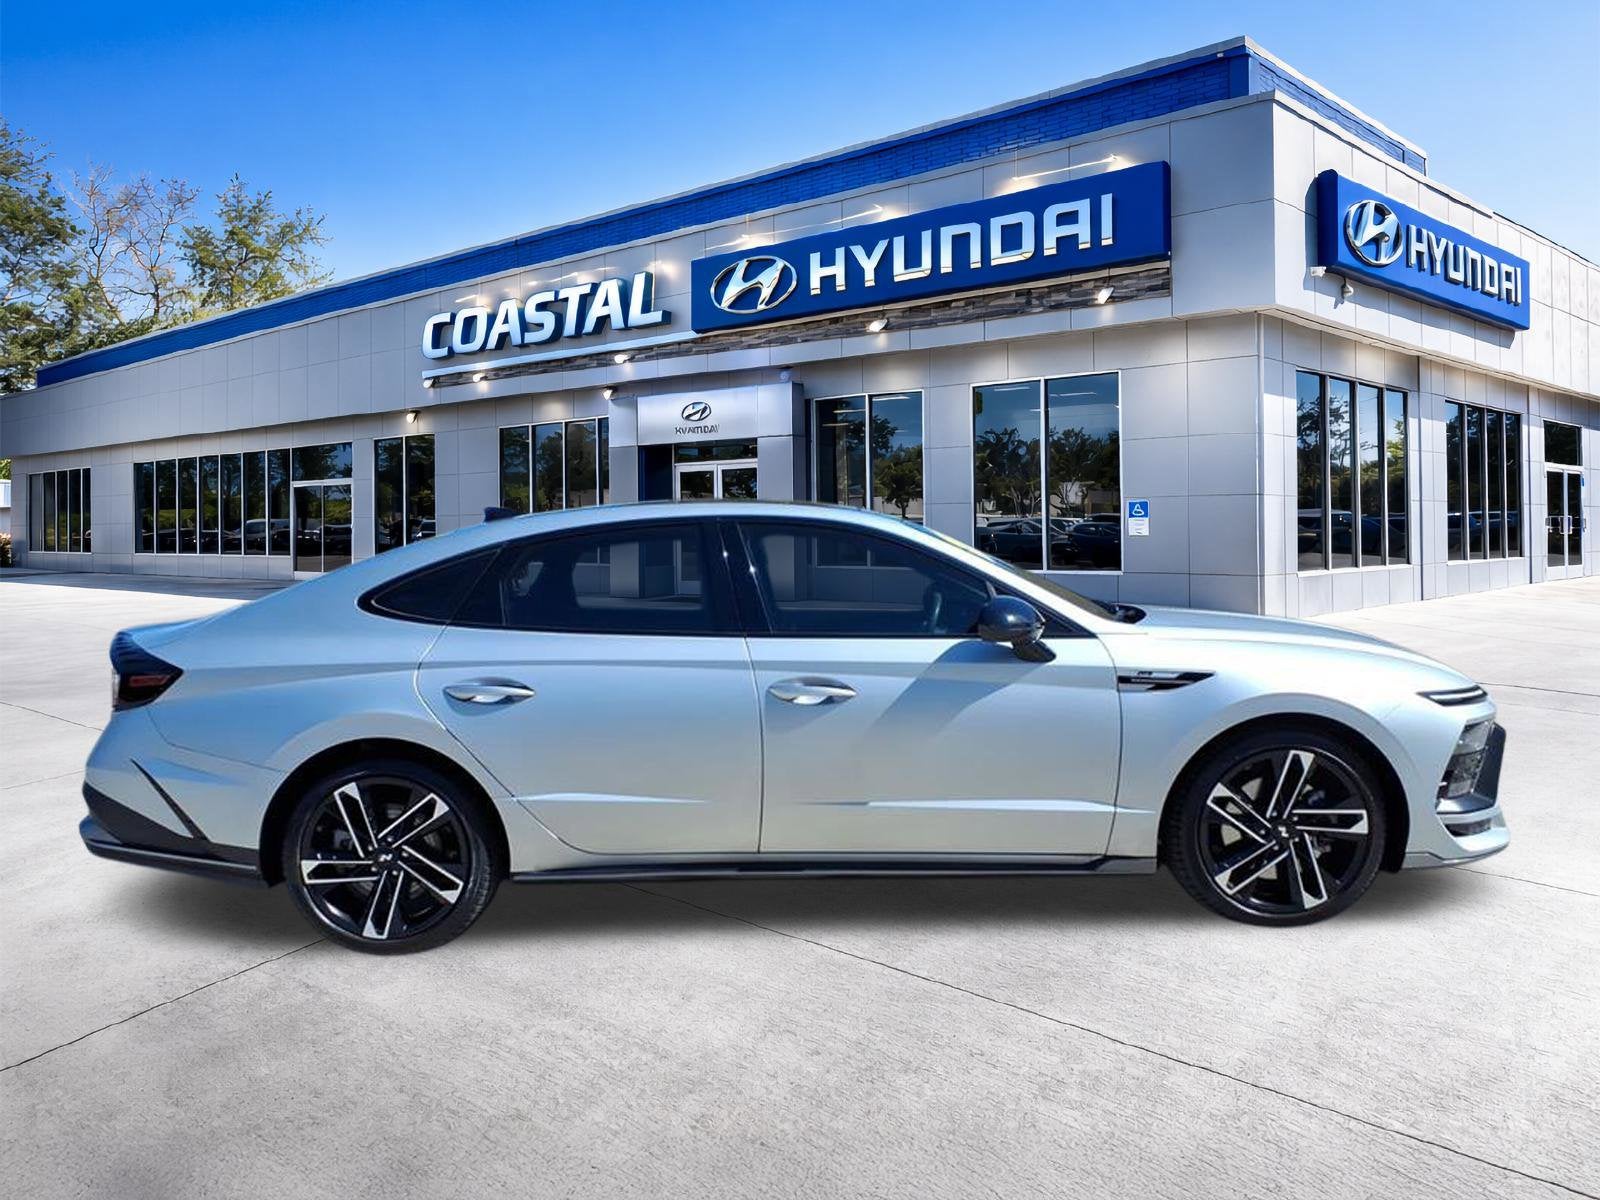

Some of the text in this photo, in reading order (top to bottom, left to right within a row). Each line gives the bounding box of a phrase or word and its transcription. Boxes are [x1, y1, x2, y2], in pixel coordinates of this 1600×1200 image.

[810, 193, 1113, 295] HYUNDAI
[1406, 224, 1521, 306] HYUNDAI
[422, 271, 669, 359] COASTAL
